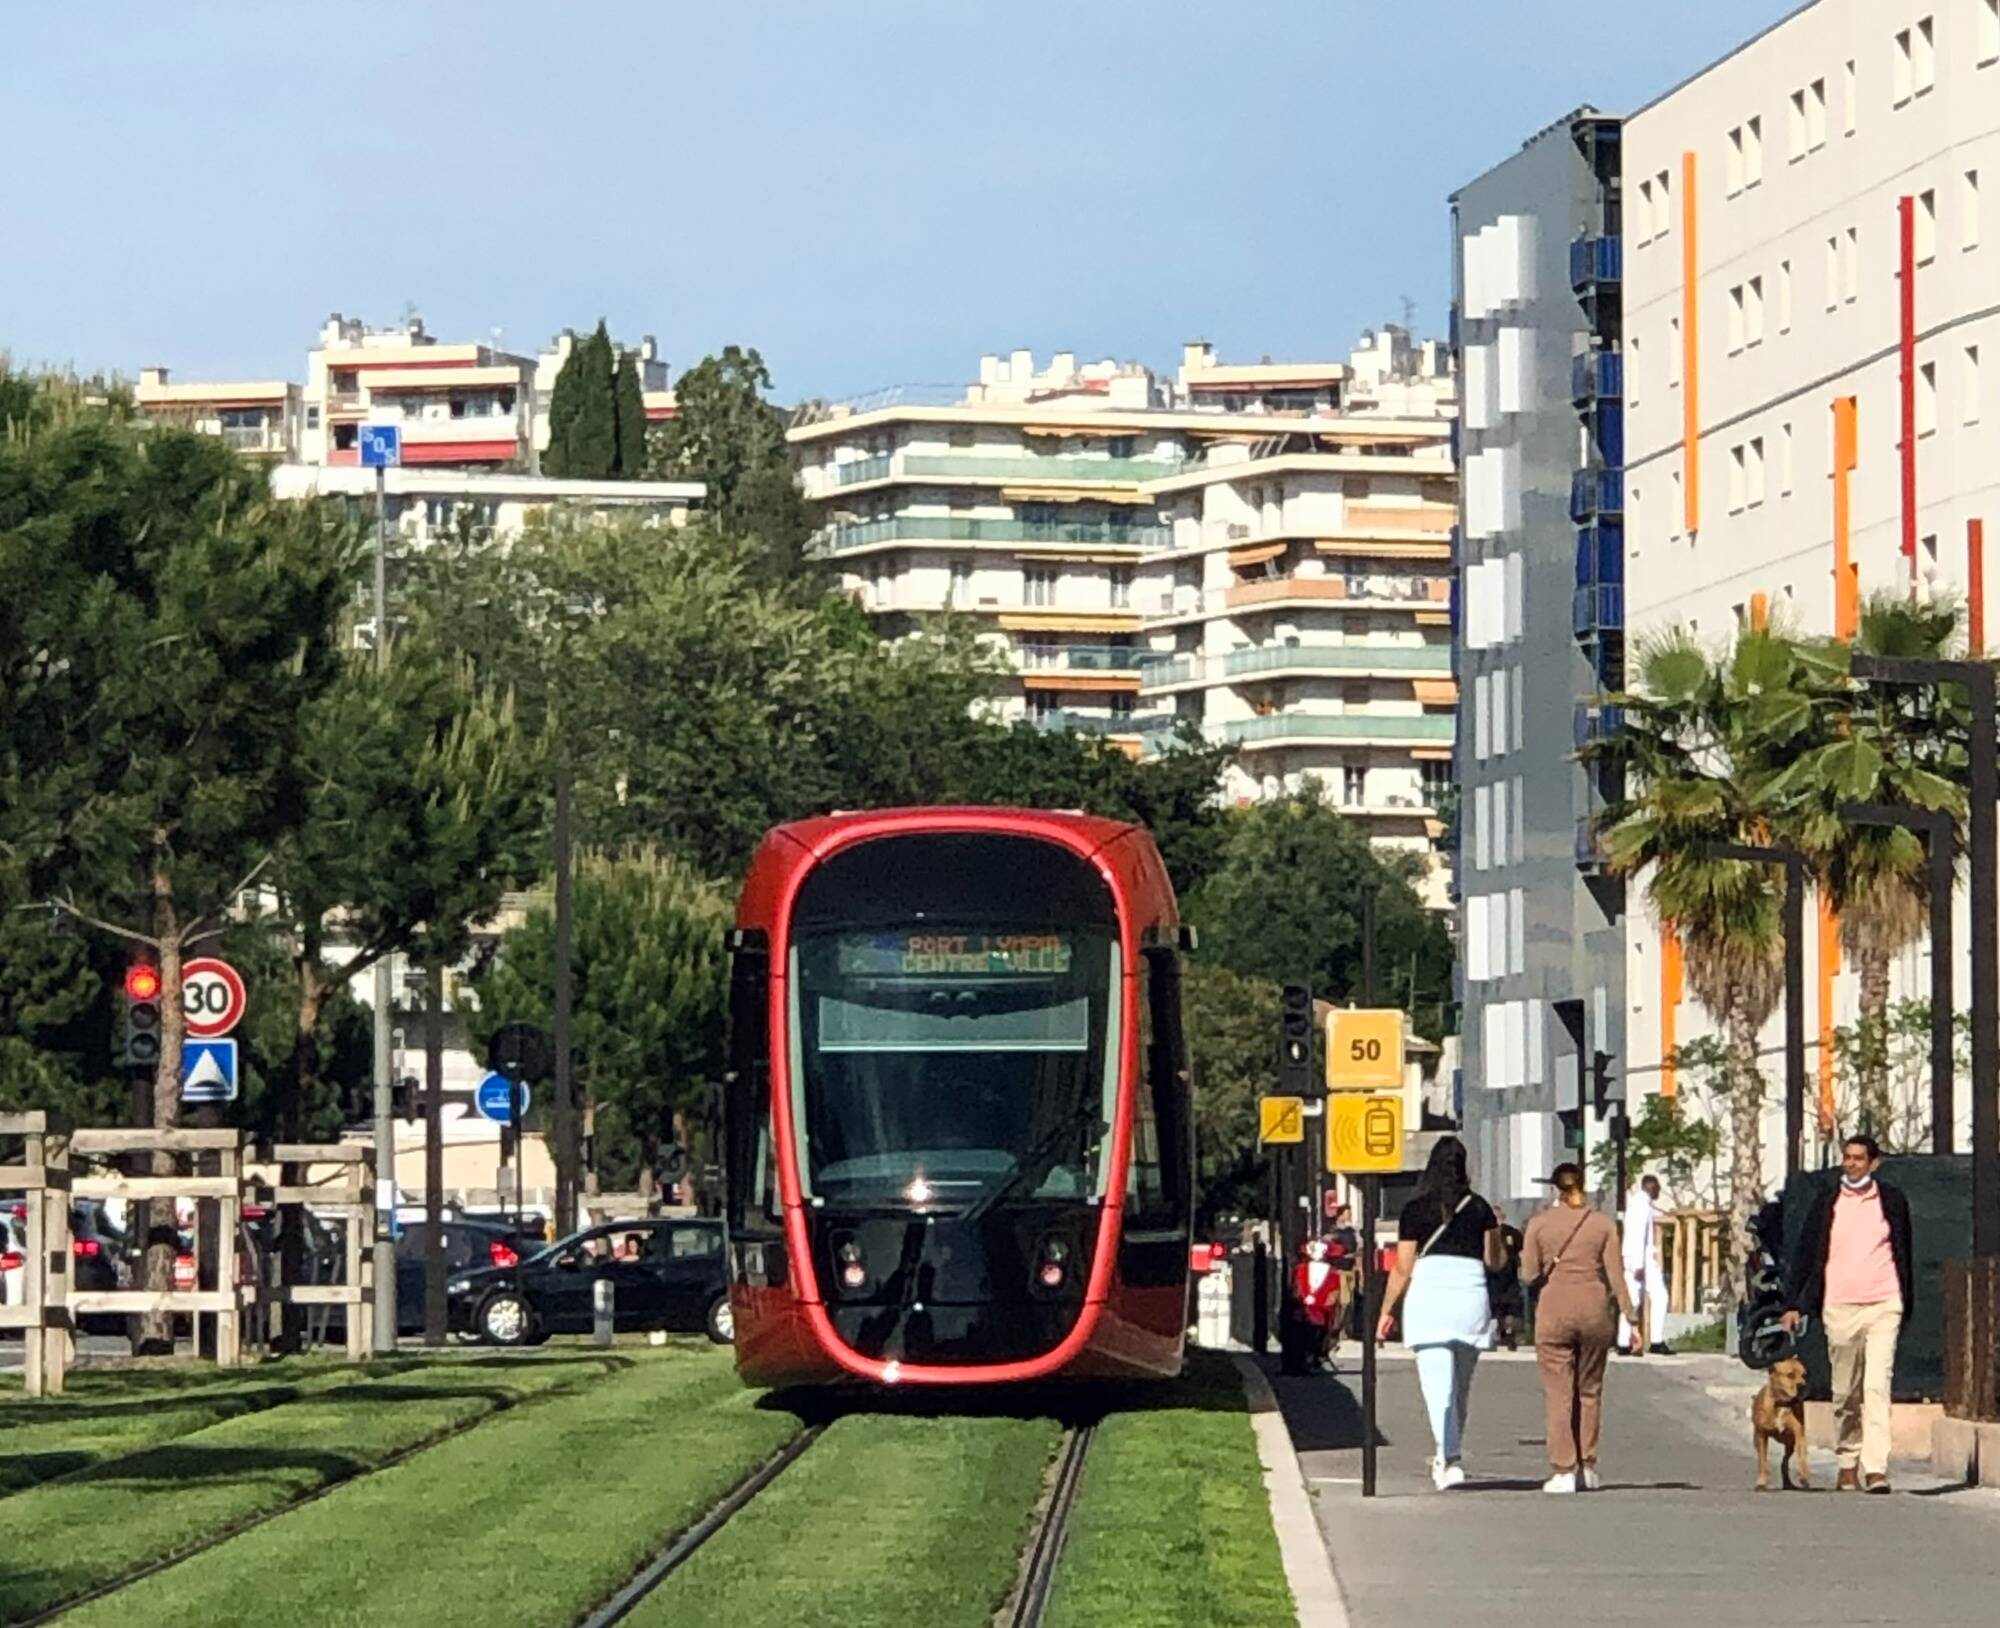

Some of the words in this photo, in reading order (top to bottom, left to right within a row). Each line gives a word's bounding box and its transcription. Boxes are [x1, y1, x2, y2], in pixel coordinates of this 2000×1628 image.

[361, 427, 397, 465] SOS
[908, 936, 968, 955] PORT
[902, 953, 990, 973] CENTRE
[184, 982, 229, 1014] 30
[1351, 1038, 1381, 1061] 50
